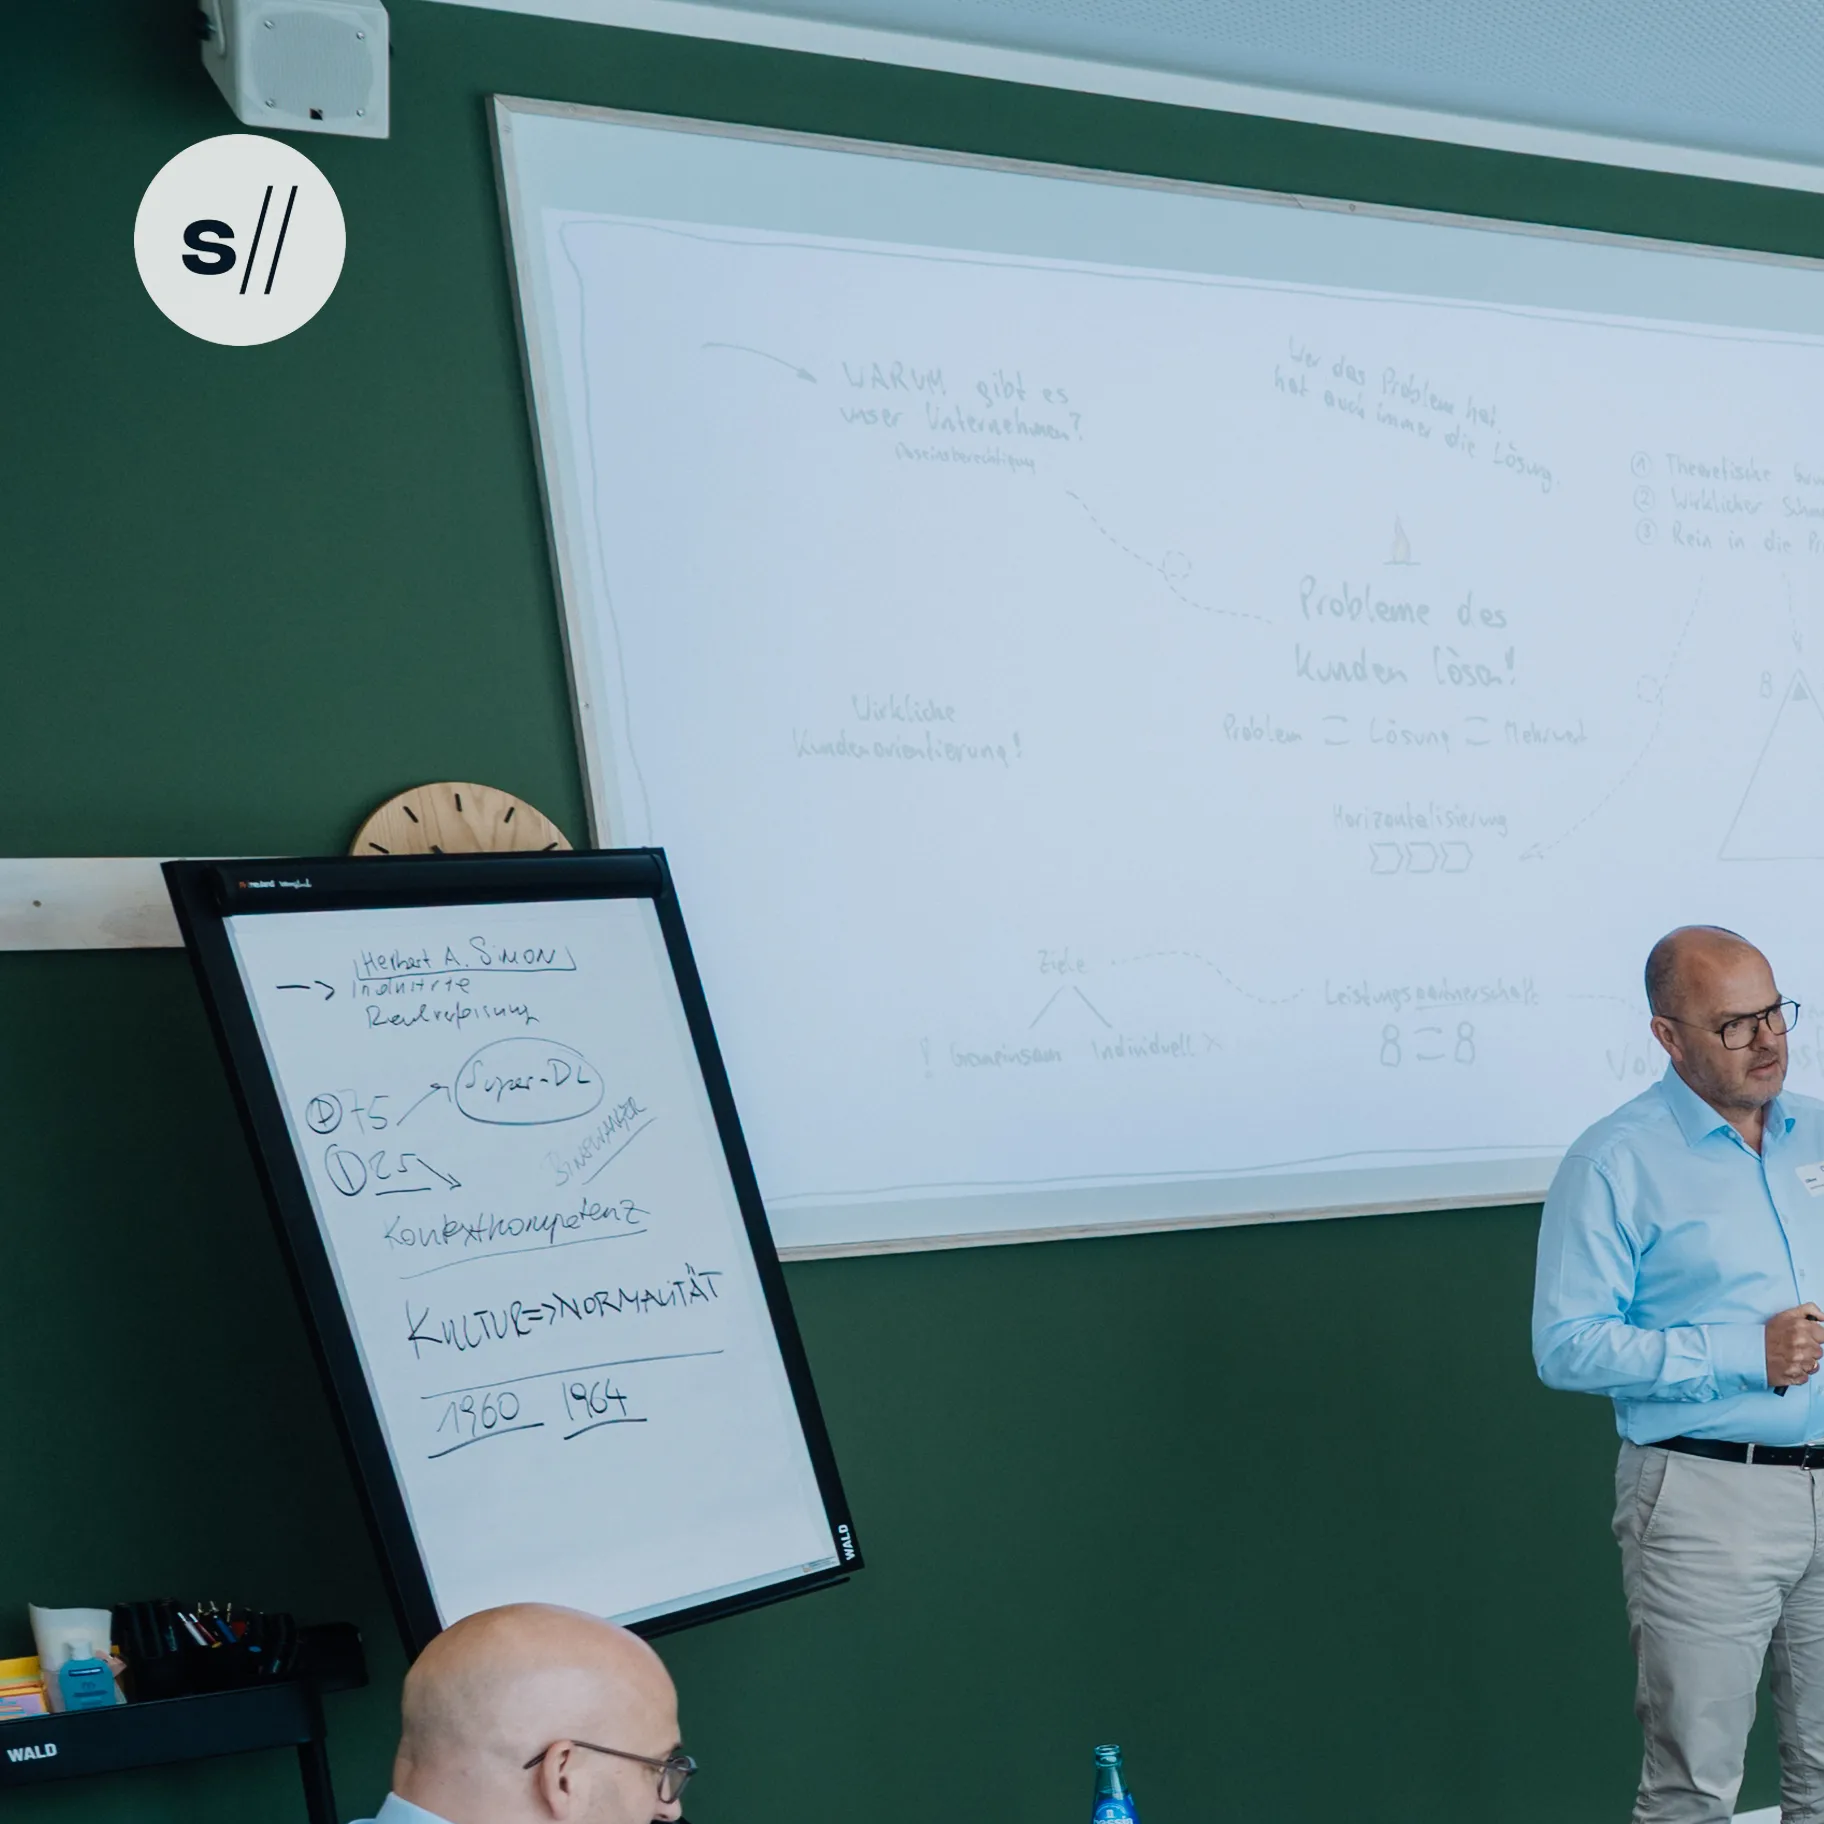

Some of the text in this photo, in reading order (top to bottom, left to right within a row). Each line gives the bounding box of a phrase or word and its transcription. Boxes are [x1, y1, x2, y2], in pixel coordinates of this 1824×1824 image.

[976, 369, 1027, 408] gibt
[1042, 387, 1069, 405] es
[1376, 402, 1432, 439] immer
[1445, 424, 1477, 459] die
[1672, 520, 1713, 549] Rein
[1728, 530, 1745, 551] in
[1764, 530, 1792, 554] die
[1299, 575, 1507, 629] Probleme des
[1295, 643, 1408, 684] Kunden
[1223, 713, 1302, 743] Problem
[562, 1378, 628, 1422] 1964
[838, 1524, 856, 1561] WALD
[6, 1743, 58, 1764] WALD
